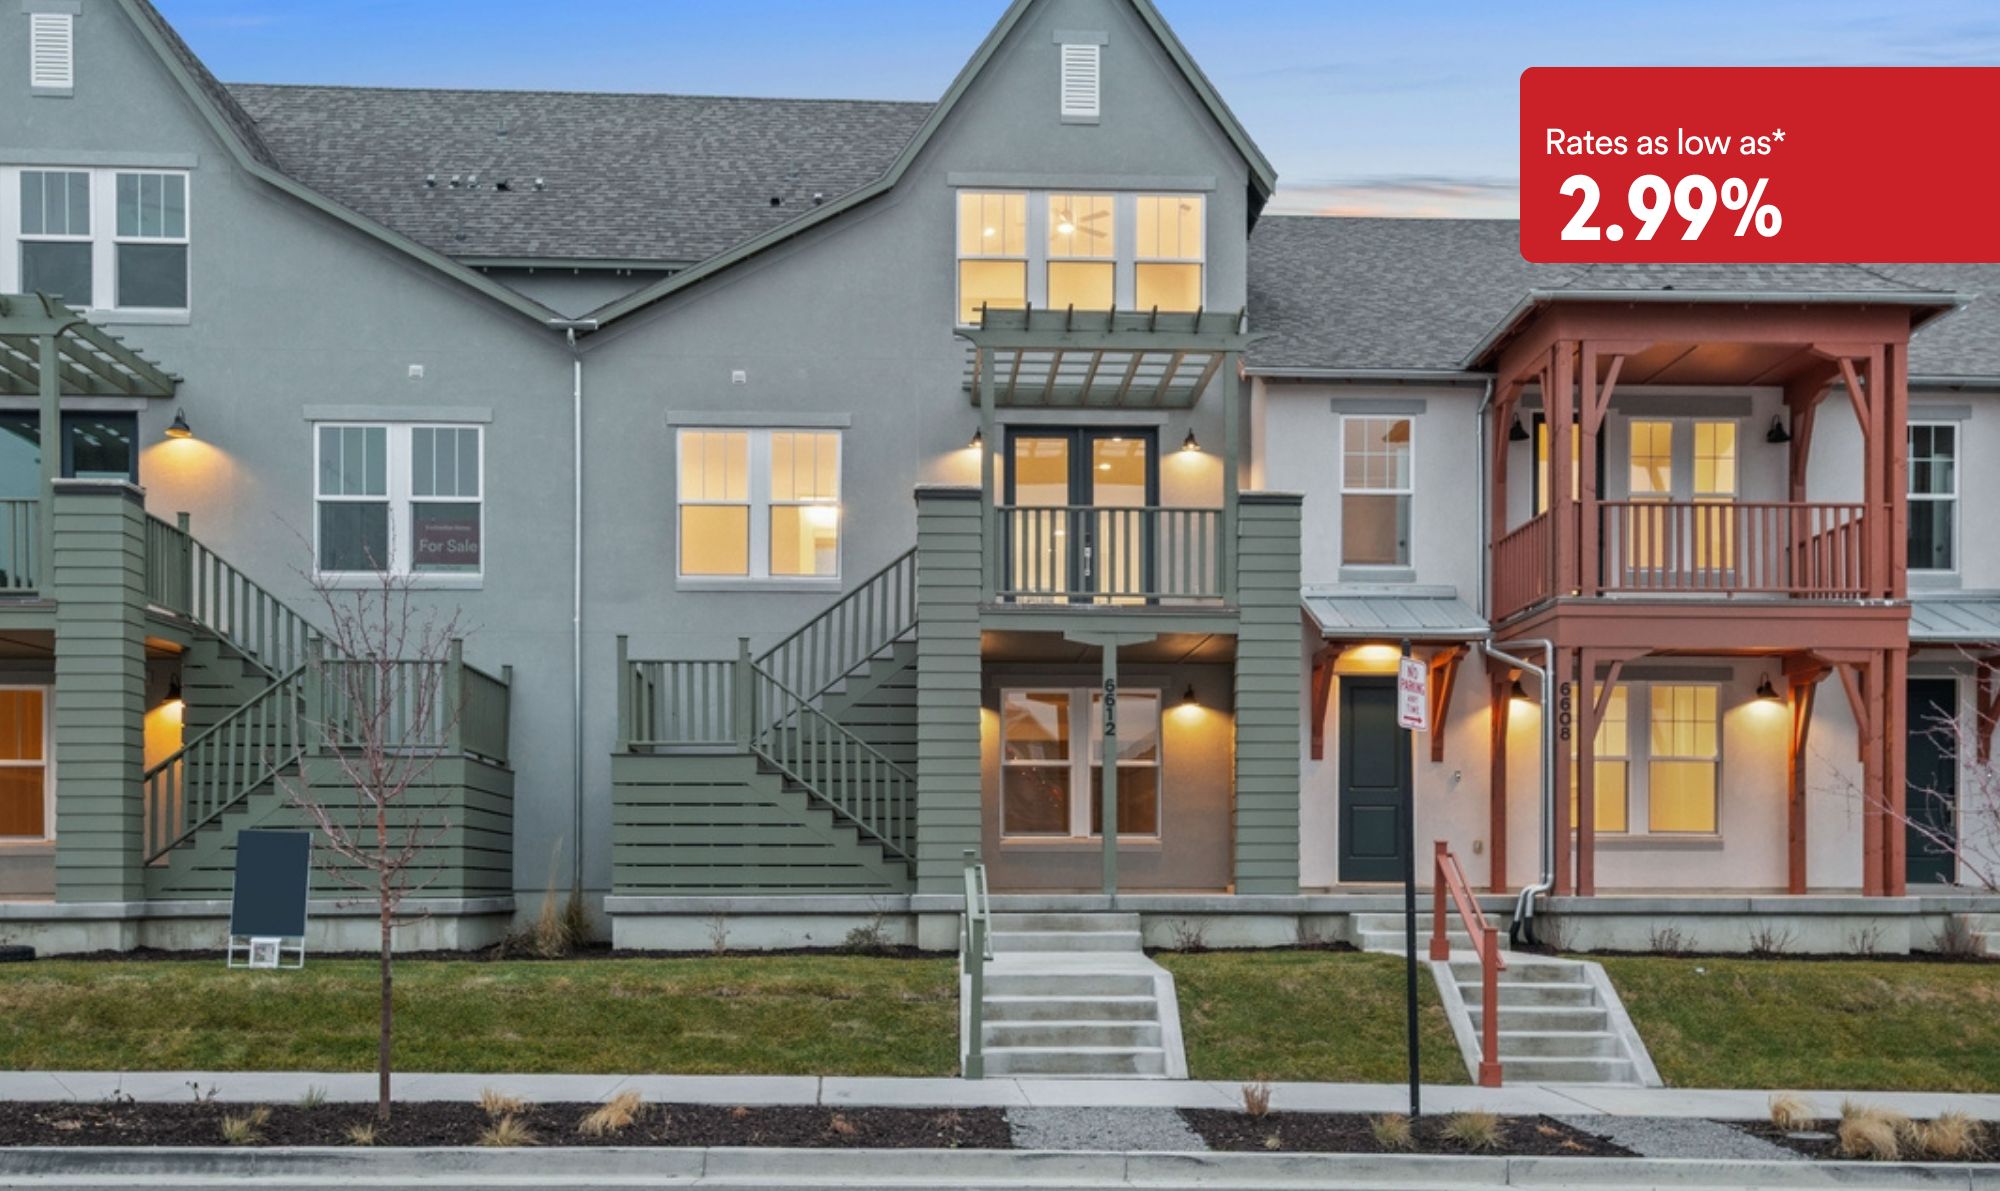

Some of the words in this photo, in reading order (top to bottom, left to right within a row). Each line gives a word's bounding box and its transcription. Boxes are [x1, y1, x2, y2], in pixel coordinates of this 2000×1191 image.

[419, 538, 444, 553] For
[447, 538, 478, 553] Sale
[1407, 665, 1419, 680] NO
[1399, 678, 1425, 696] PARKING
[1104, 678, 1116, 736] 6612
[1559, 681, 1571, 741] 6608
